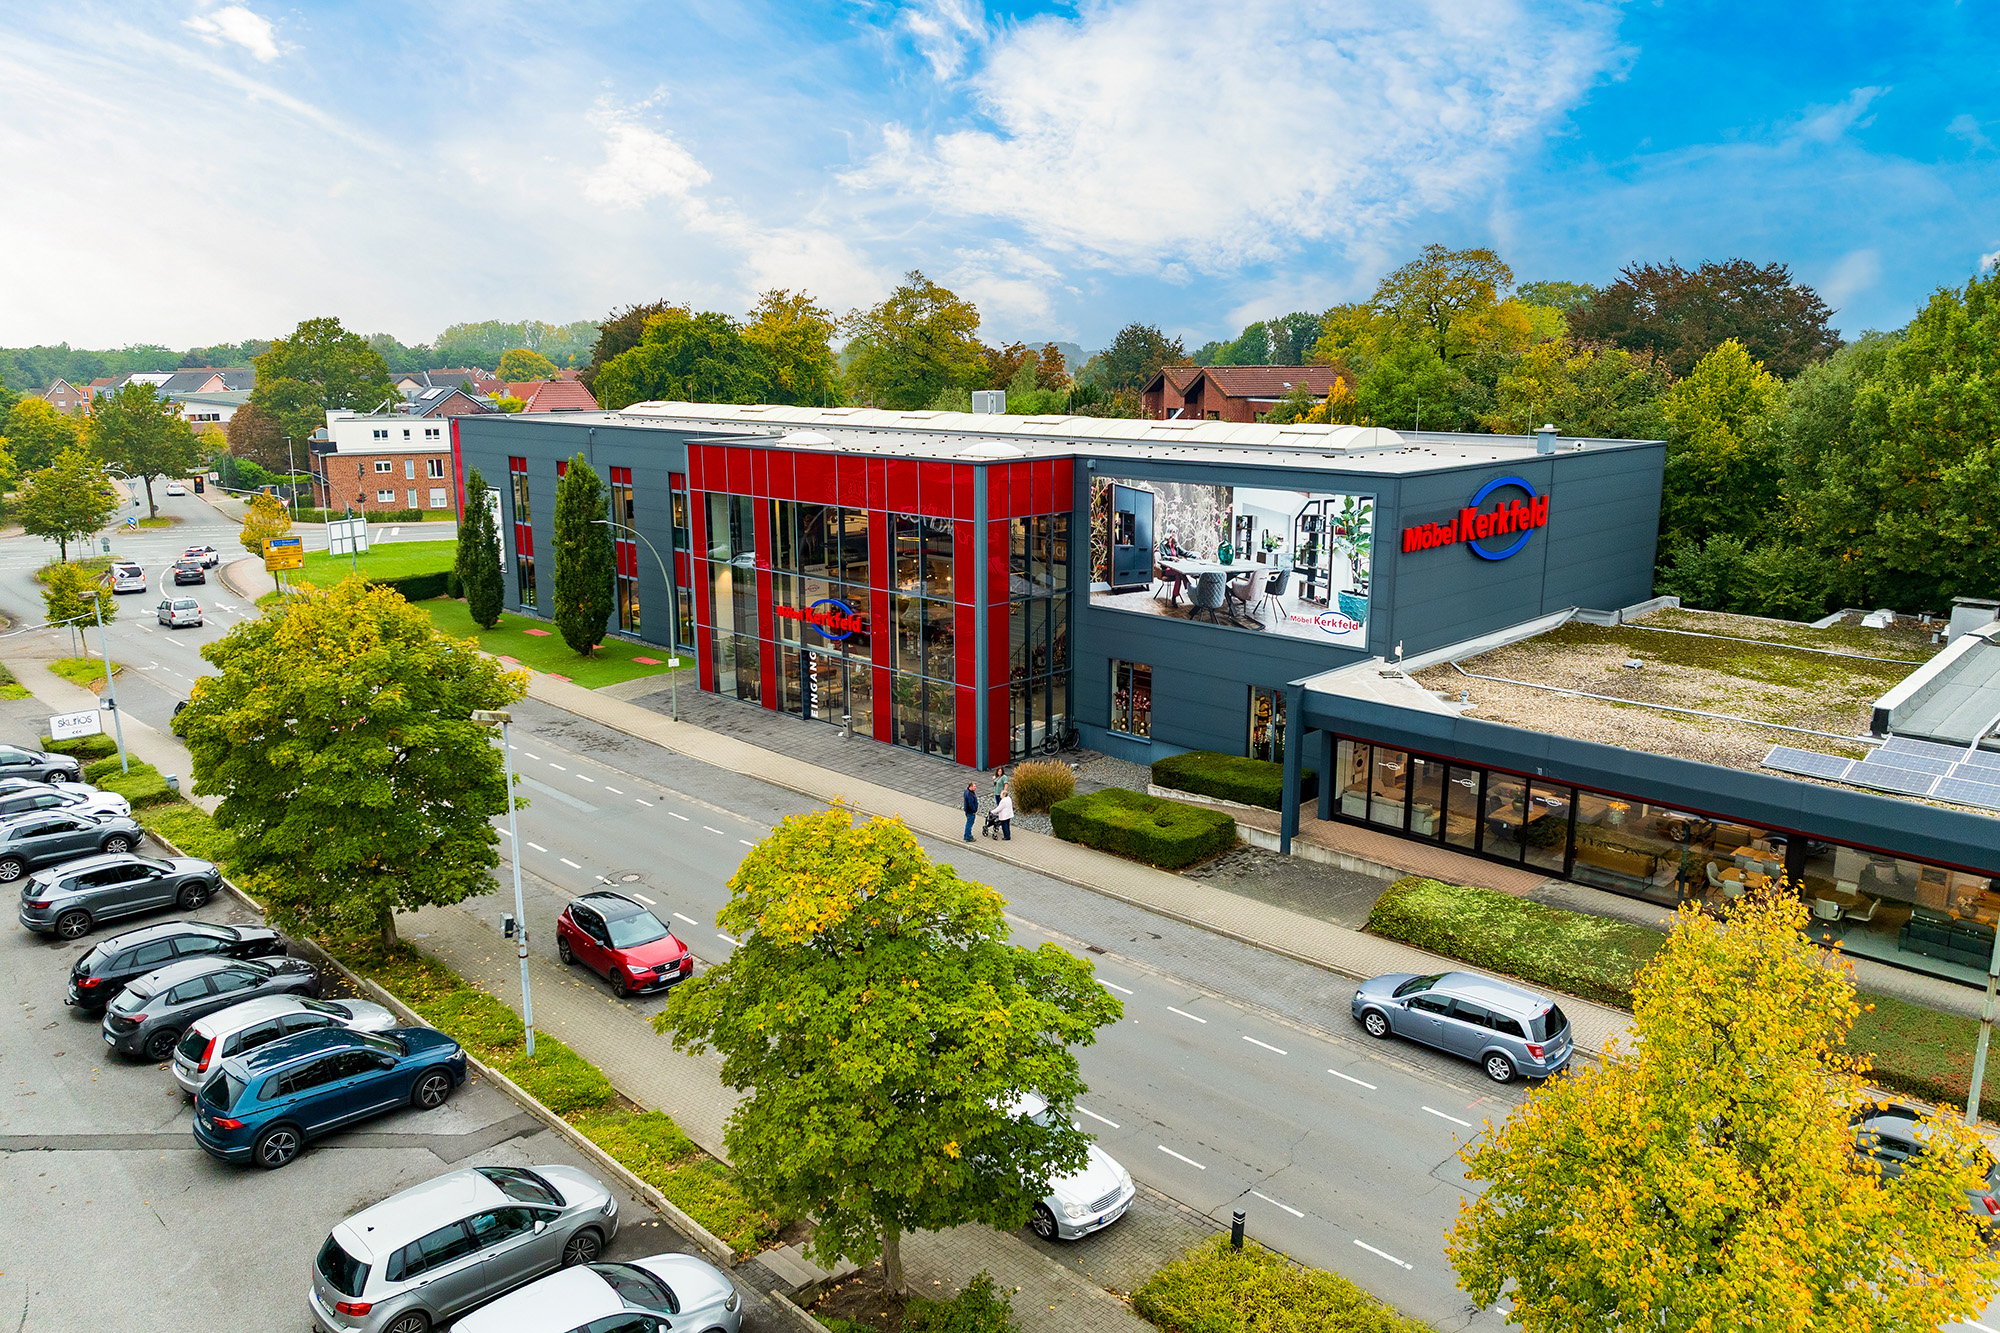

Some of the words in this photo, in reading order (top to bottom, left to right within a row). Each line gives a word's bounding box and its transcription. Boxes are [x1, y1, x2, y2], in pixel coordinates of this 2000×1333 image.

[1402, 519, 1458, 553] Möbel
[1458, 495, 1549, 542] Kerkfeld
[805, 607, 862, 633] Kerkfeld
[1314, 616, 1359, 631] Kerkfeld
[809, 651, 819, 718] EINGANG
